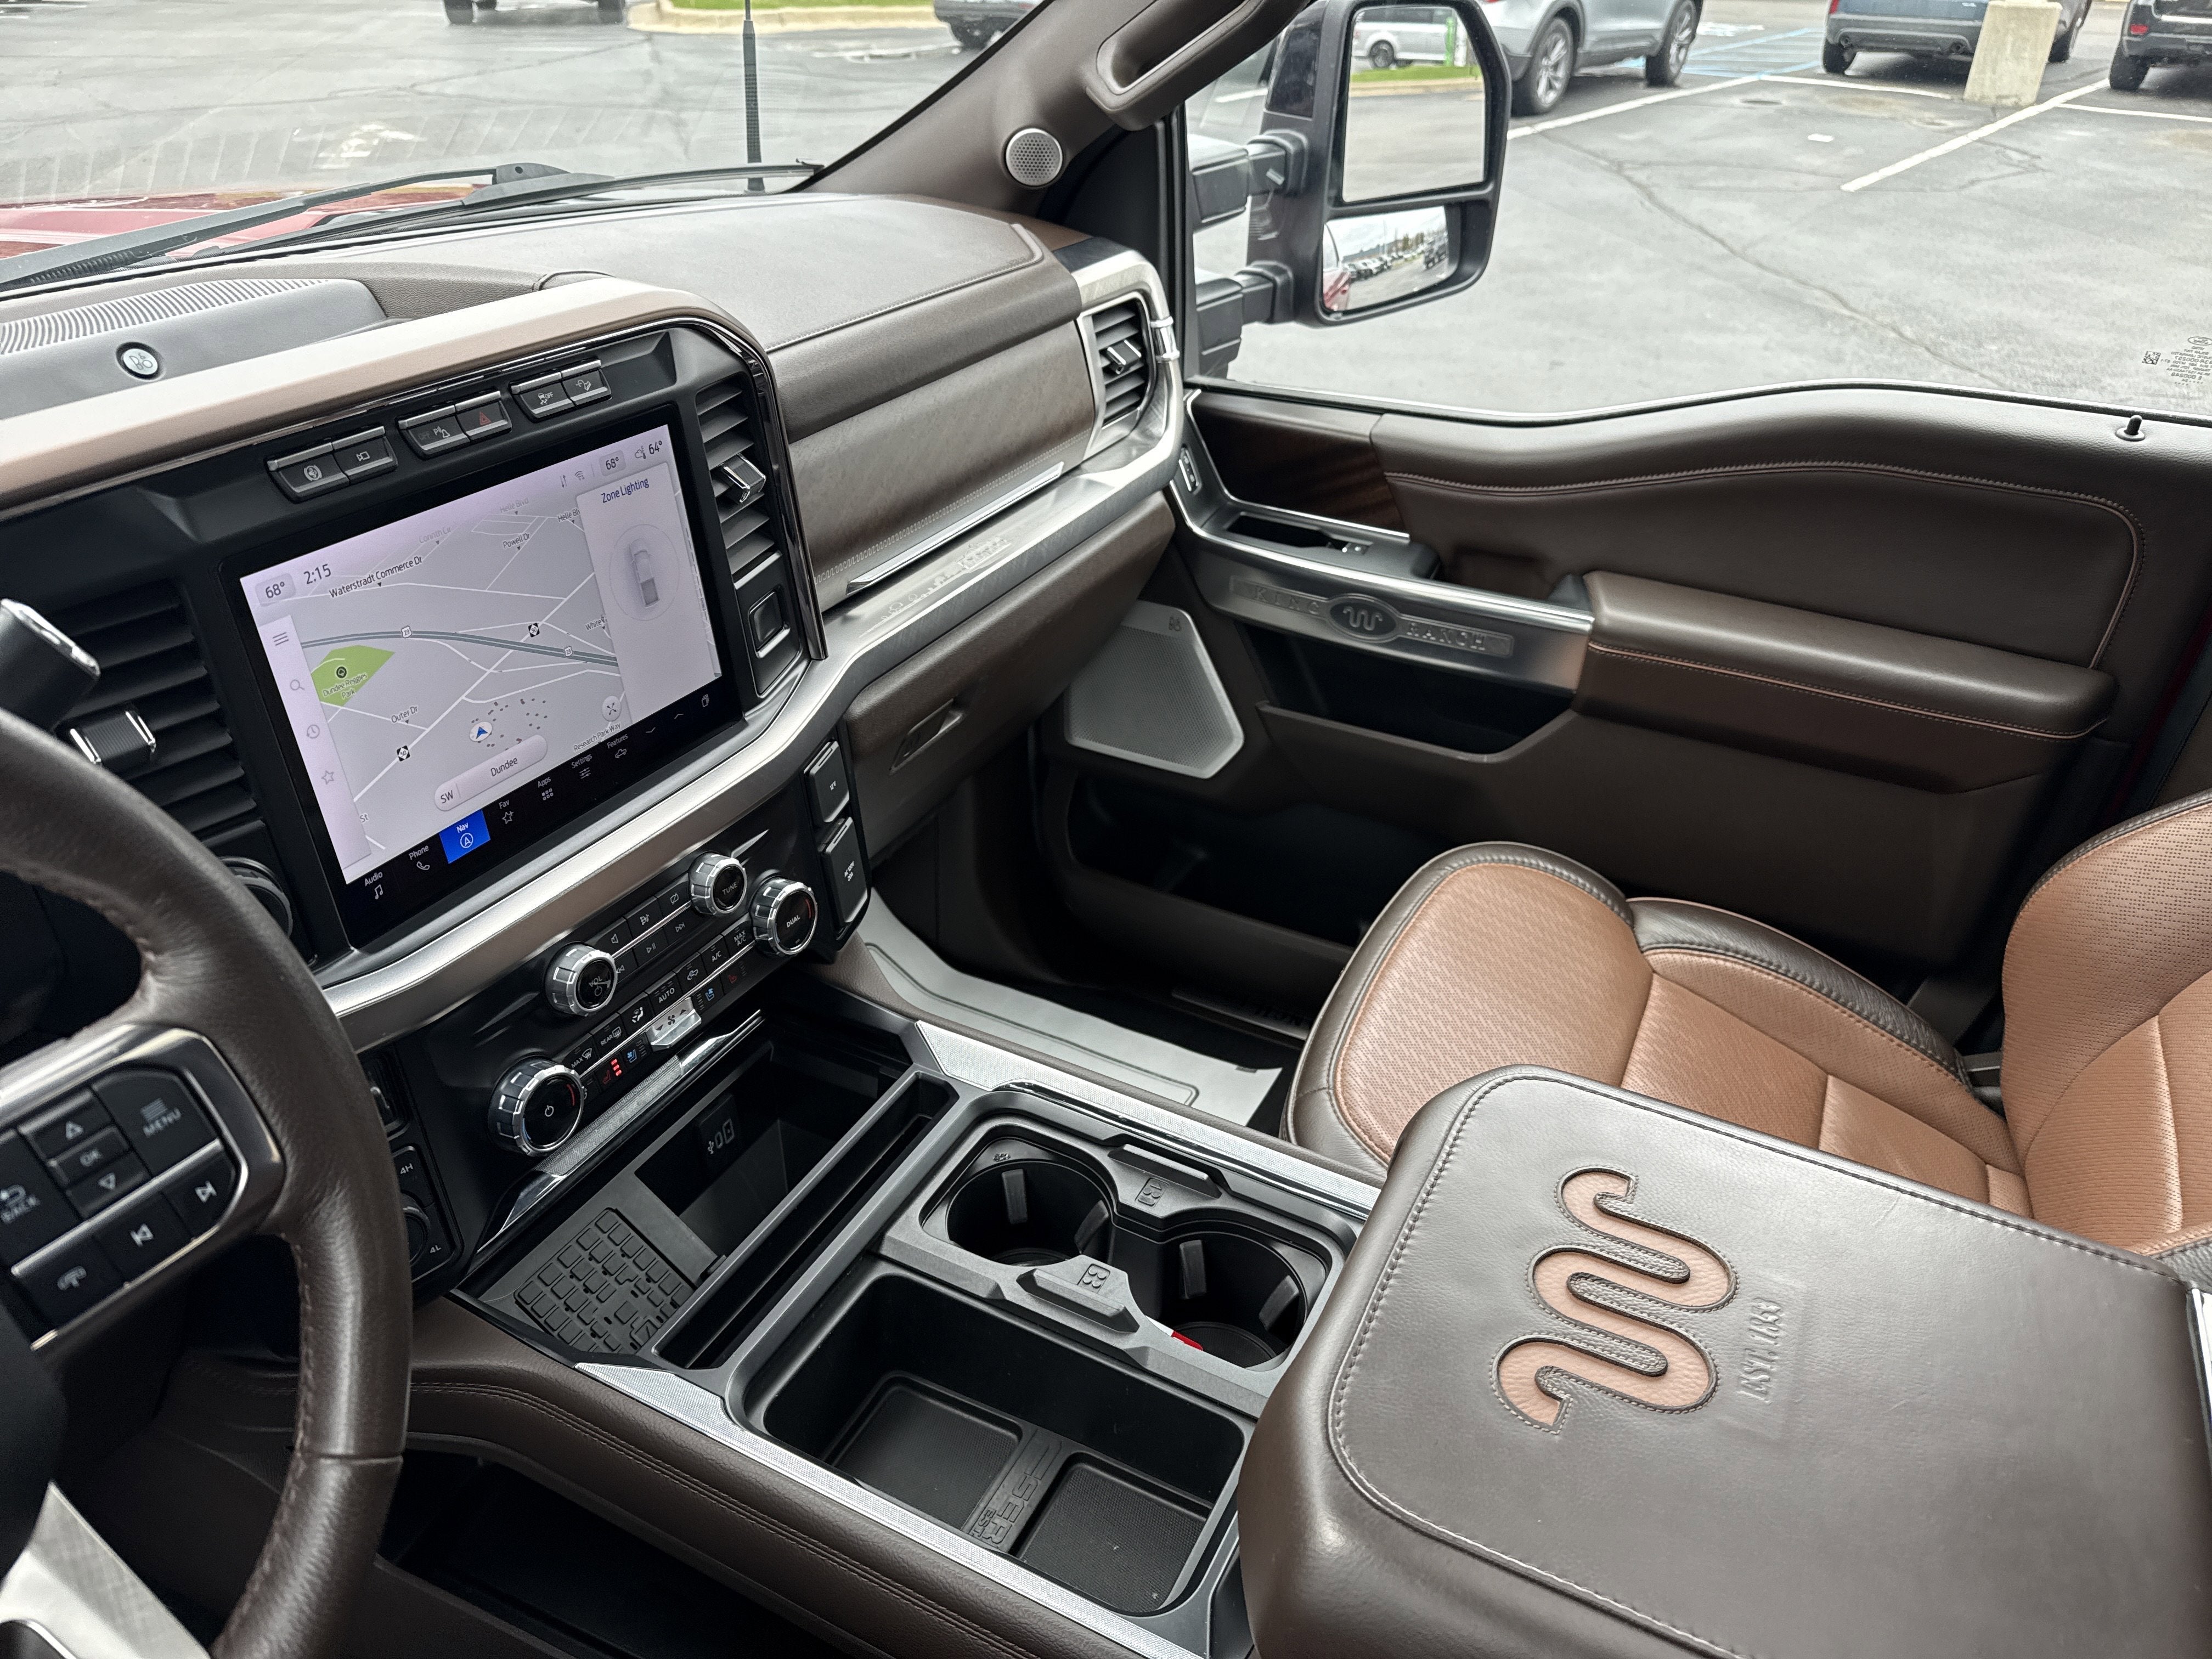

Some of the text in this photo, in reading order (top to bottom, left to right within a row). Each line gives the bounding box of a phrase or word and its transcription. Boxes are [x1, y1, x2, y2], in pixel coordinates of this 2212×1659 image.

[648, 441, 662, 455] 64°
[606, 457, 619, 470] 68°
[601, 478, 650, 503] Zone Lighting
[503, 533, 531, 549] Powell Dr
[303, 563, 331, 585] 2:15
[329, 556, 423, 598] Waterstradt Commerce Dr
[265, 582, 285, 599] 68°
[323, 682, 345, 697] Dundee
[341, 689, 356, 699] Park
[391, 706, 418, 724] Outer Dr
[573, 723, 621, 752] Research Park Way
[607, 733, 629, 749] Features
[571, 753, 592, 769] Settings
[441, 757, 518, 804] SW Dundee
[537, 776, 551, 788] Apps
[499, 799, 510, 809] Fav
[360, 813, 369, 823] St
[456, 822, 469, 833] Nav
[409, 845, 430, 860] Phone
[365, 871, 383, 887] Audio
[722, 882, 738, 895] TUNE
[786, 915, 801, 928] DUAL
[733, 930, 747, 942] MAX
[737, 936, 747, 947] A/C
[712, 950, 722, 962] A/C
[589, 975, 602, 987] VOL
[658, 988, 675, 1004] AUTO
[600, 1034, 613, 1046] REAR
[571, 1057, 584, 1068] MAX
[143, 1107, 182, 1138] MENU
[80, 1148, 103, 1167] OK
[400, 1163, 414, 1175] 4H
[430, 1244, 442, 1254] 4L
